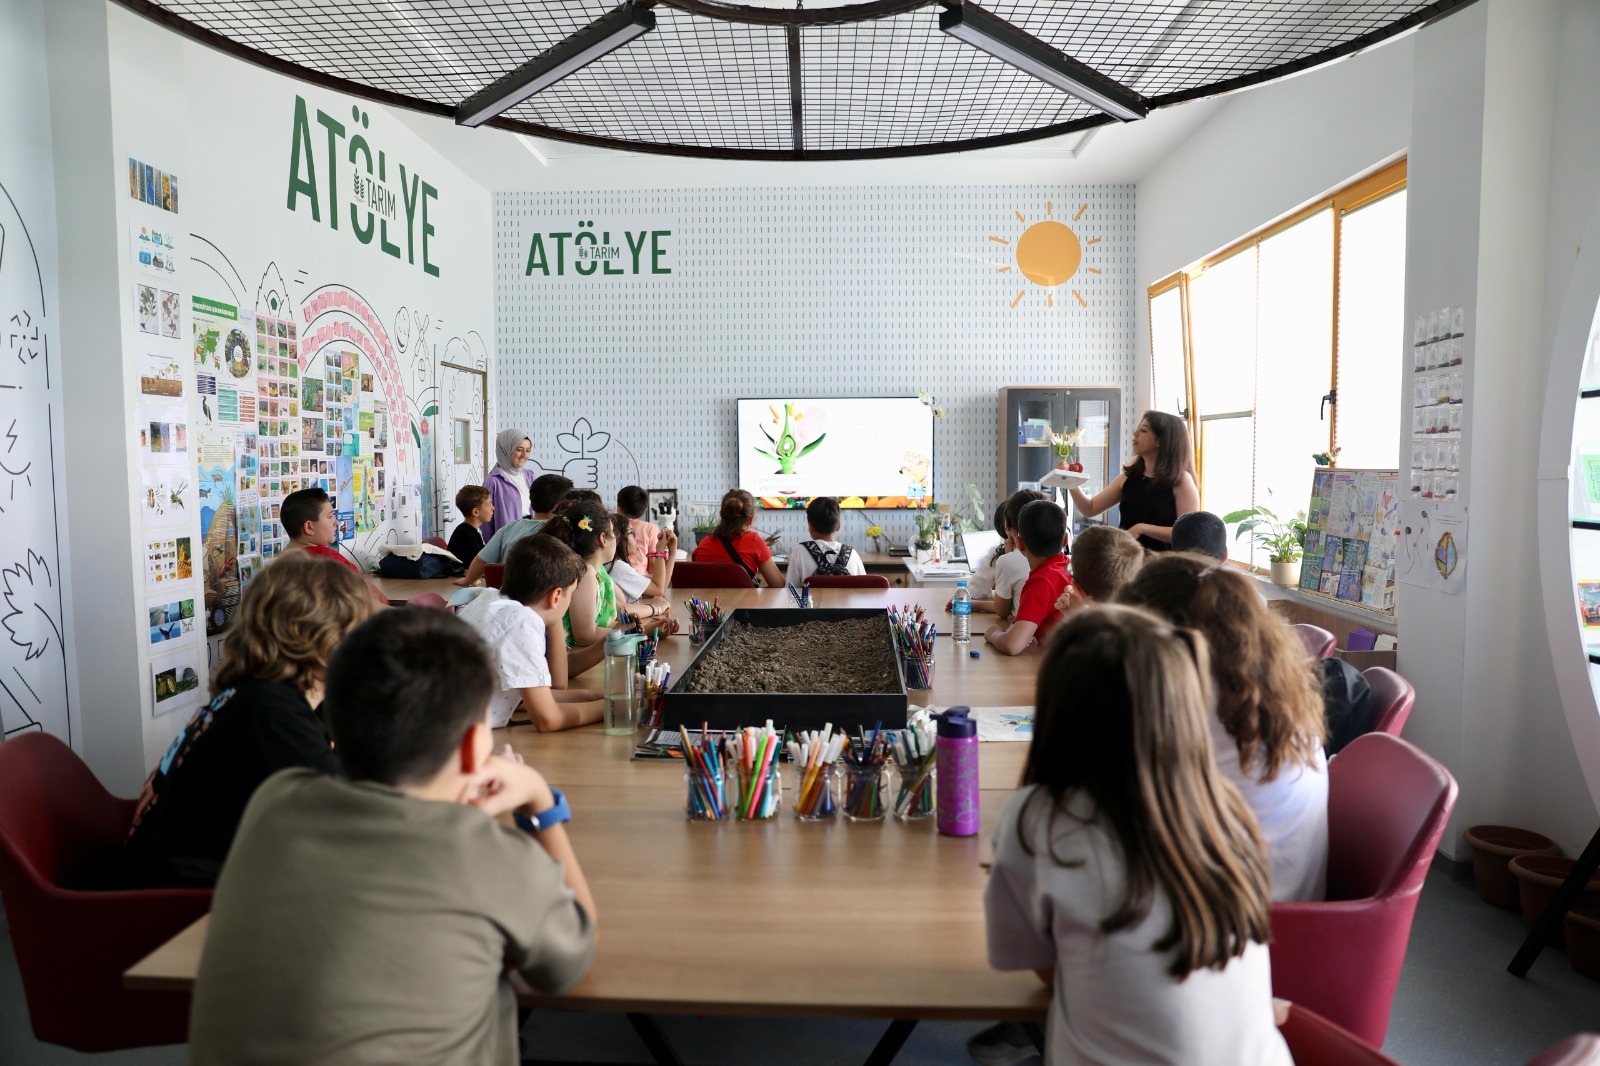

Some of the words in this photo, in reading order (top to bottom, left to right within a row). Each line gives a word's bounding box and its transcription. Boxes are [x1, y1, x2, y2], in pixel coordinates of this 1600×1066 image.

[286, 95, 440, 277] ATÖLYE
[366, 178, 396, 221] TARIM
[525, 221, 672, 277] ATÖLYE
[590, 246, 620, 260] TARIM
